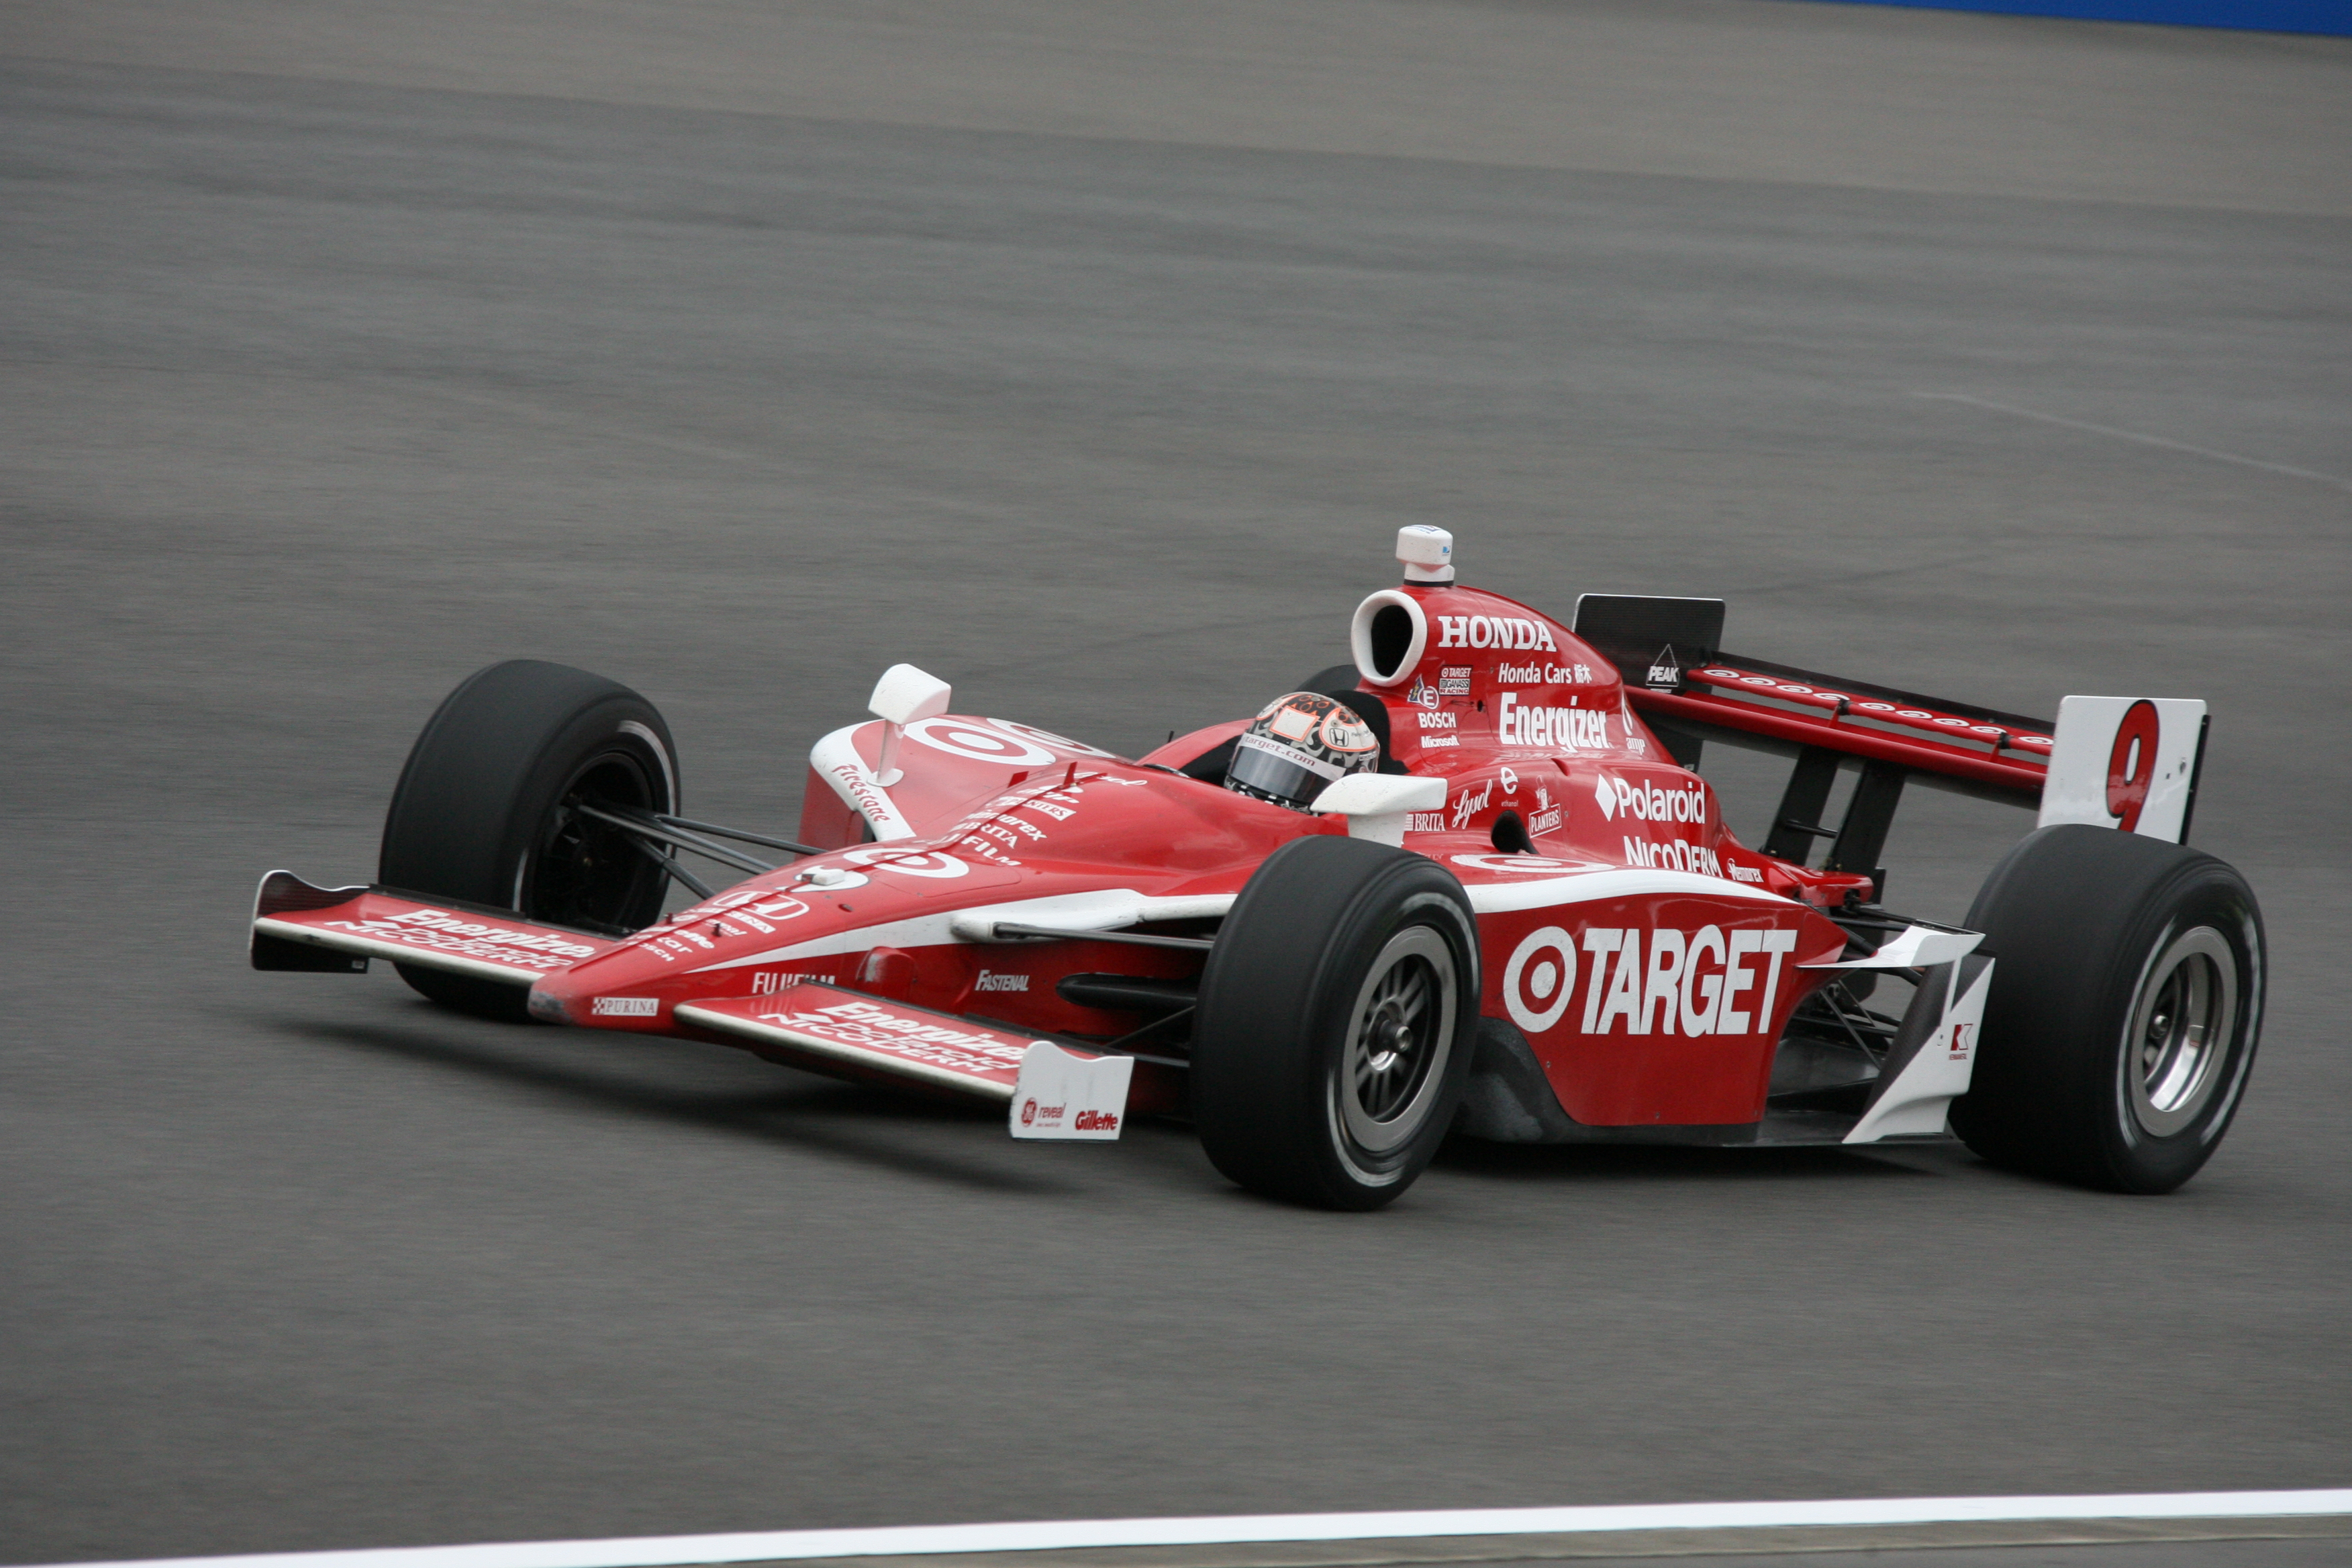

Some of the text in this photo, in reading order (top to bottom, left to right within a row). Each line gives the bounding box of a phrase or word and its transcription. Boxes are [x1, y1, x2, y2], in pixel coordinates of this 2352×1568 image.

[1438, 616, 1557, 652] HONDA
[1449, 667, 1472, 678] TARGET
[1498, 661, 1541, 683] Honda
[1545, 663, 1572, 684] Cars
[1649, 665, 1679, 682] PEAK
[1418, 712, 1457, 728] BOSCH
[1499, 692, 1610, 752] Energizer
[1245, 736, 1316, 767] target.com
[1420, 735, 1460, 748] Microsoft
[2106, 699, 2160, 833] 9
[831, 763, 891, 822] Firestone
[1452, 779, 1493, 829] Lysol
[1613, 779, 1706, 824] Polaroid
[1414, 813, 1447, 832] BRITA
[1530, 809, 1560, 833] PLANTERS
[1581, 924, 1798, 1038] TARGET
[606, 999, 657, 1014] PURINA
[1038, 1102, 1067, 1119] reveal
[1075, 1110, 1119, 1131] Gillette
